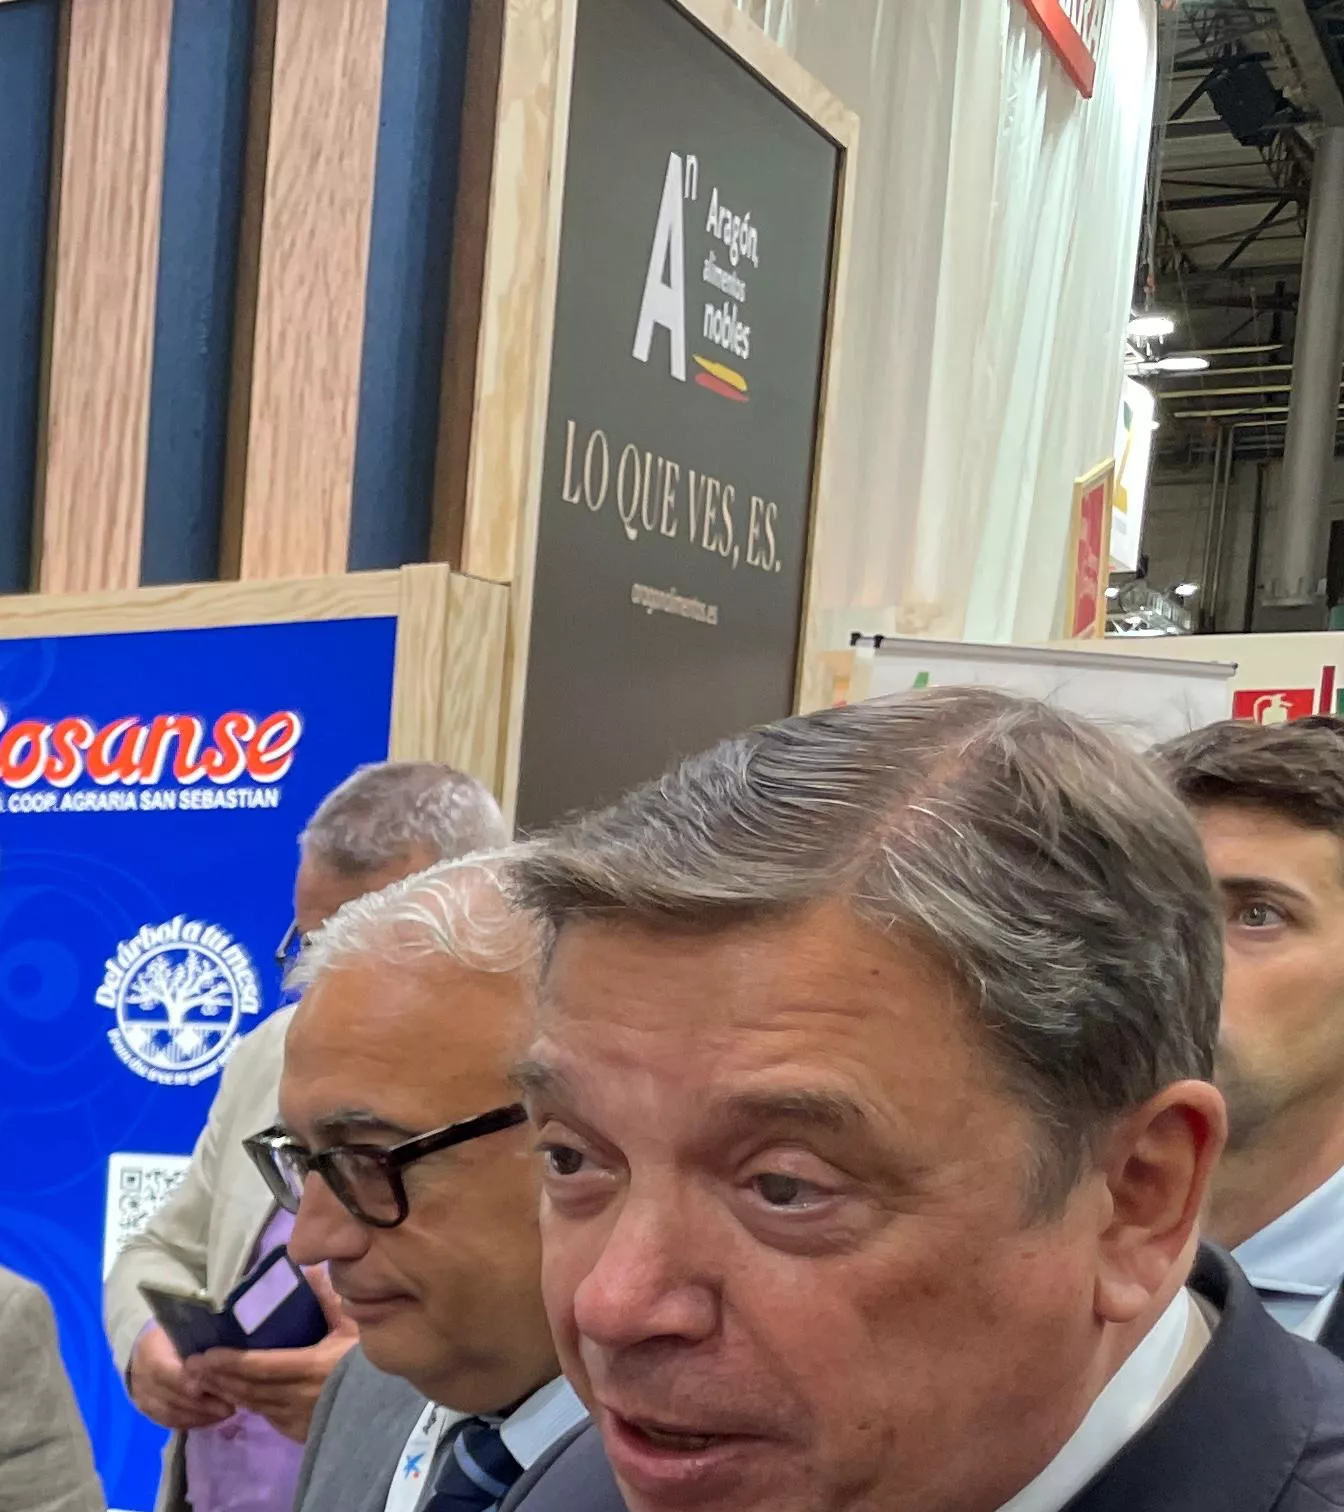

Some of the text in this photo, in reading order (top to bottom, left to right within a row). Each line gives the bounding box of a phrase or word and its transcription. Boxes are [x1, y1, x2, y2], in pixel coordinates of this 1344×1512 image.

[705, 186, 760, 269] Aragón,
[703, 301, 752, 360] nobles
[562, 419, 784, 574] LO QUE VES, ES.
[8, 790, 58, 813] COOP.
[59, 789, 138, 812] AGRARIA
[139, 788, 177, 811] SAN
[178, 786, 282, 810] SEBASTIAN
